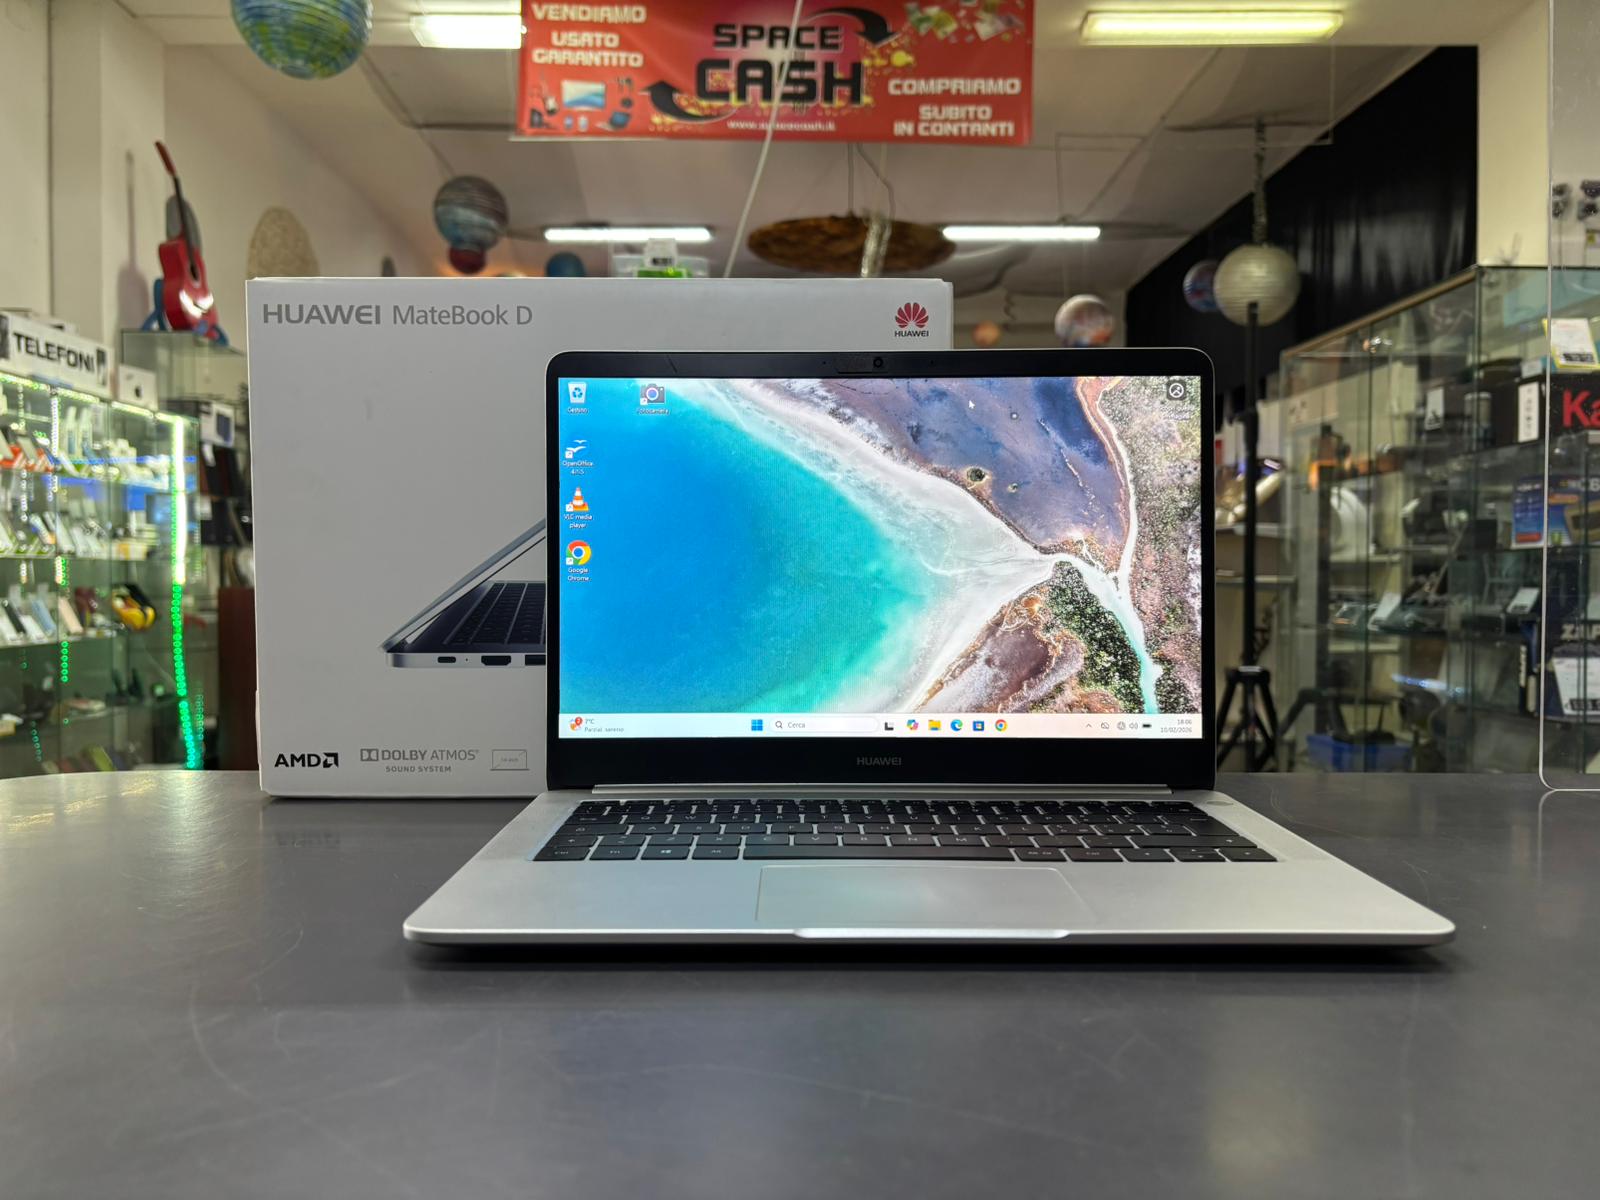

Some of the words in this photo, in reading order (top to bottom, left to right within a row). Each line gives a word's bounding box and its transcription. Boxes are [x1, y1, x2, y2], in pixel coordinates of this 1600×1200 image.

[531, 4, 647, 24] VENDIAMO
[551, 31, 620, 49] USATO
[713, 23, 840, 50] SPACE
[532, 48, 644, 68] GARANTITO
[695, 58, 862, 105] CASH
[888, 77, 1021, 96] COMPRIAMO
[918, 103, 992, 120] SUBITO
[893, 121, 914, 136] IN
[917, 121, 1014, 137] CONTANTI
[263, 304, 381, 325] HUAWEI
[392, 304, 508, 325] MateBook
[516, 305, 533, 325] D
[13, 332, 95, 372] TELEFONI
[568, 567, 588, 575] Google
[787, 721, 806, 729] Cerca
[274, 753, 322, 768] AMD
[381, 749, 427, 761] DOLBY
[430, 749, 476, 761] ATMOS
[856, 757, 902, 766] HUAWEI
[385, 765, 416, 773] SOUND
[418, 765, 452, 773] SYSTEM
